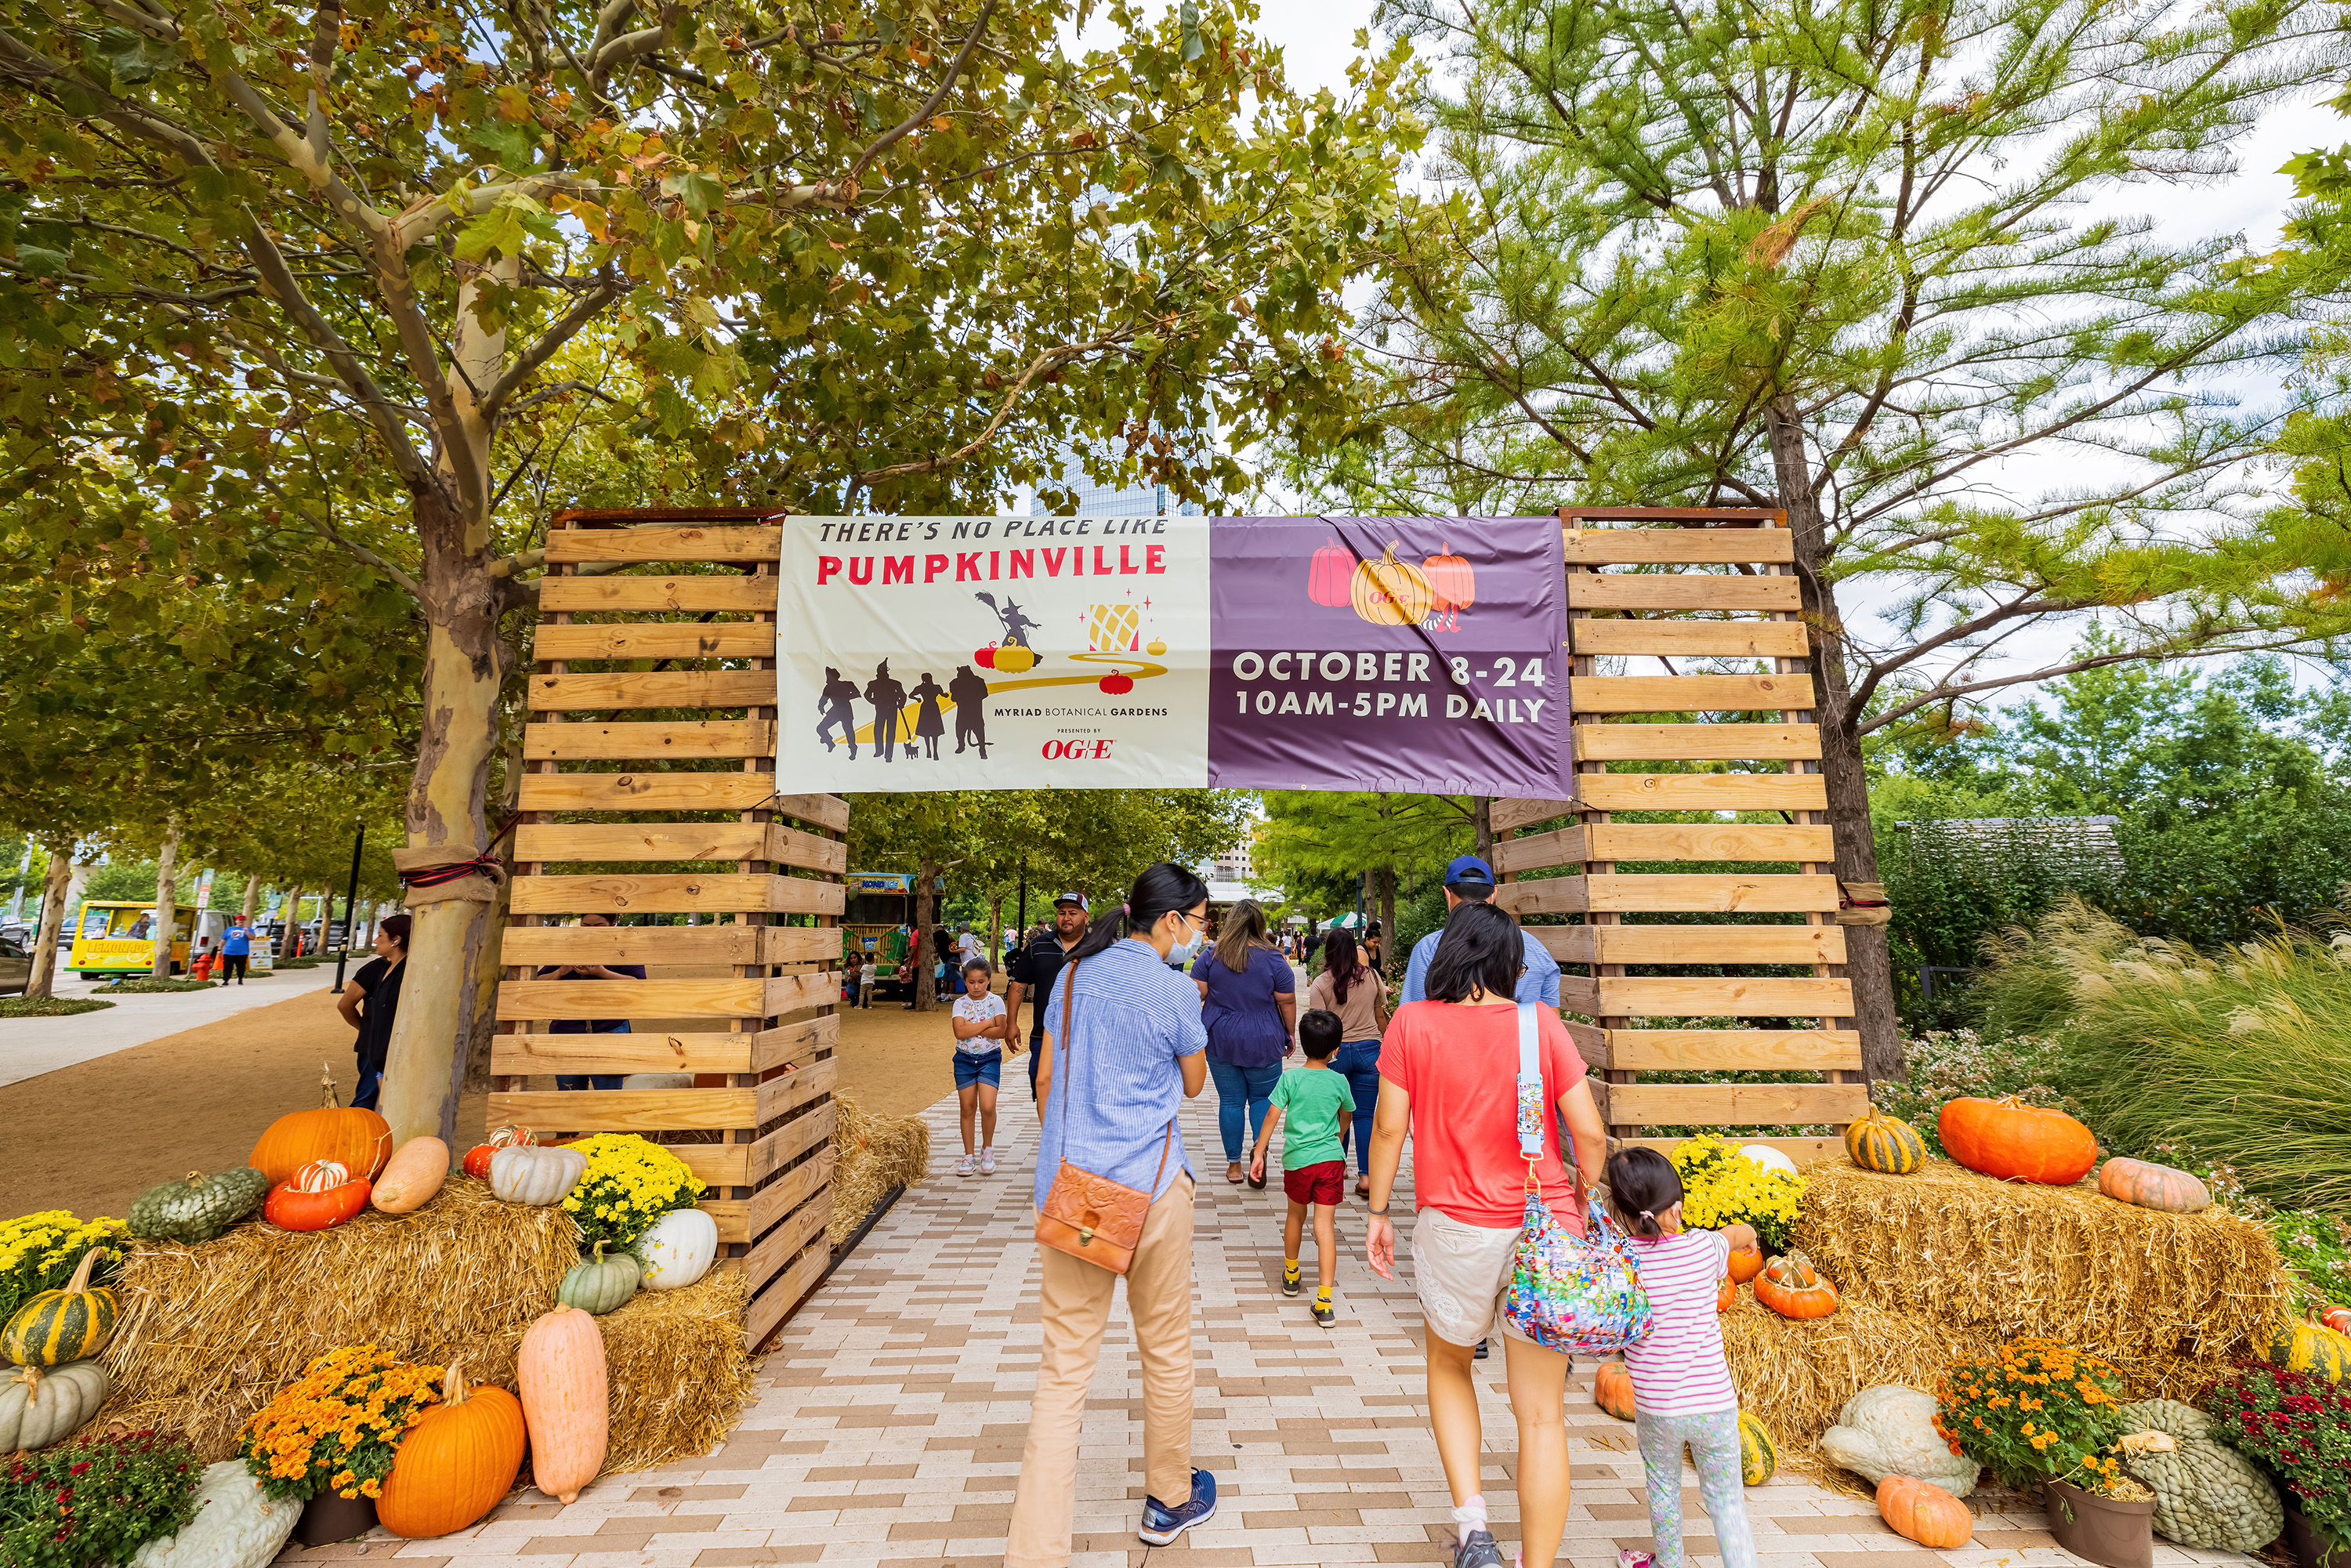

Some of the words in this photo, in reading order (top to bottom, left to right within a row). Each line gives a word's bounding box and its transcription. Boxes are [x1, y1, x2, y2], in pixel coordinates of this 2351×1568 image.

[820, 522, 940, 542] THERE'S
[951, 521, 992, 540] NO
[1003, 520, 1093, 538] PLACE
[1103, 519, 1168, 534] LIKE
[817, 544, 1167, 585] PUMPKINVILLE
[1233, 651, 1431, 682] OCTOBER
[1451, 656, 1546, 687] 8-24
[994, 708, 1042, 717] MYRIAD
[1045, 708, 1107, 716] BOTANICAL
[1110, 708, 1168, 716] GARDENS
[1236, 690, 1429, 717] 10AM-5PM
[1446, 694, 1546, 722] DAILY
[885, 880, 899, 889] ICE
[87, 942, 150, 953] LEMONADE
